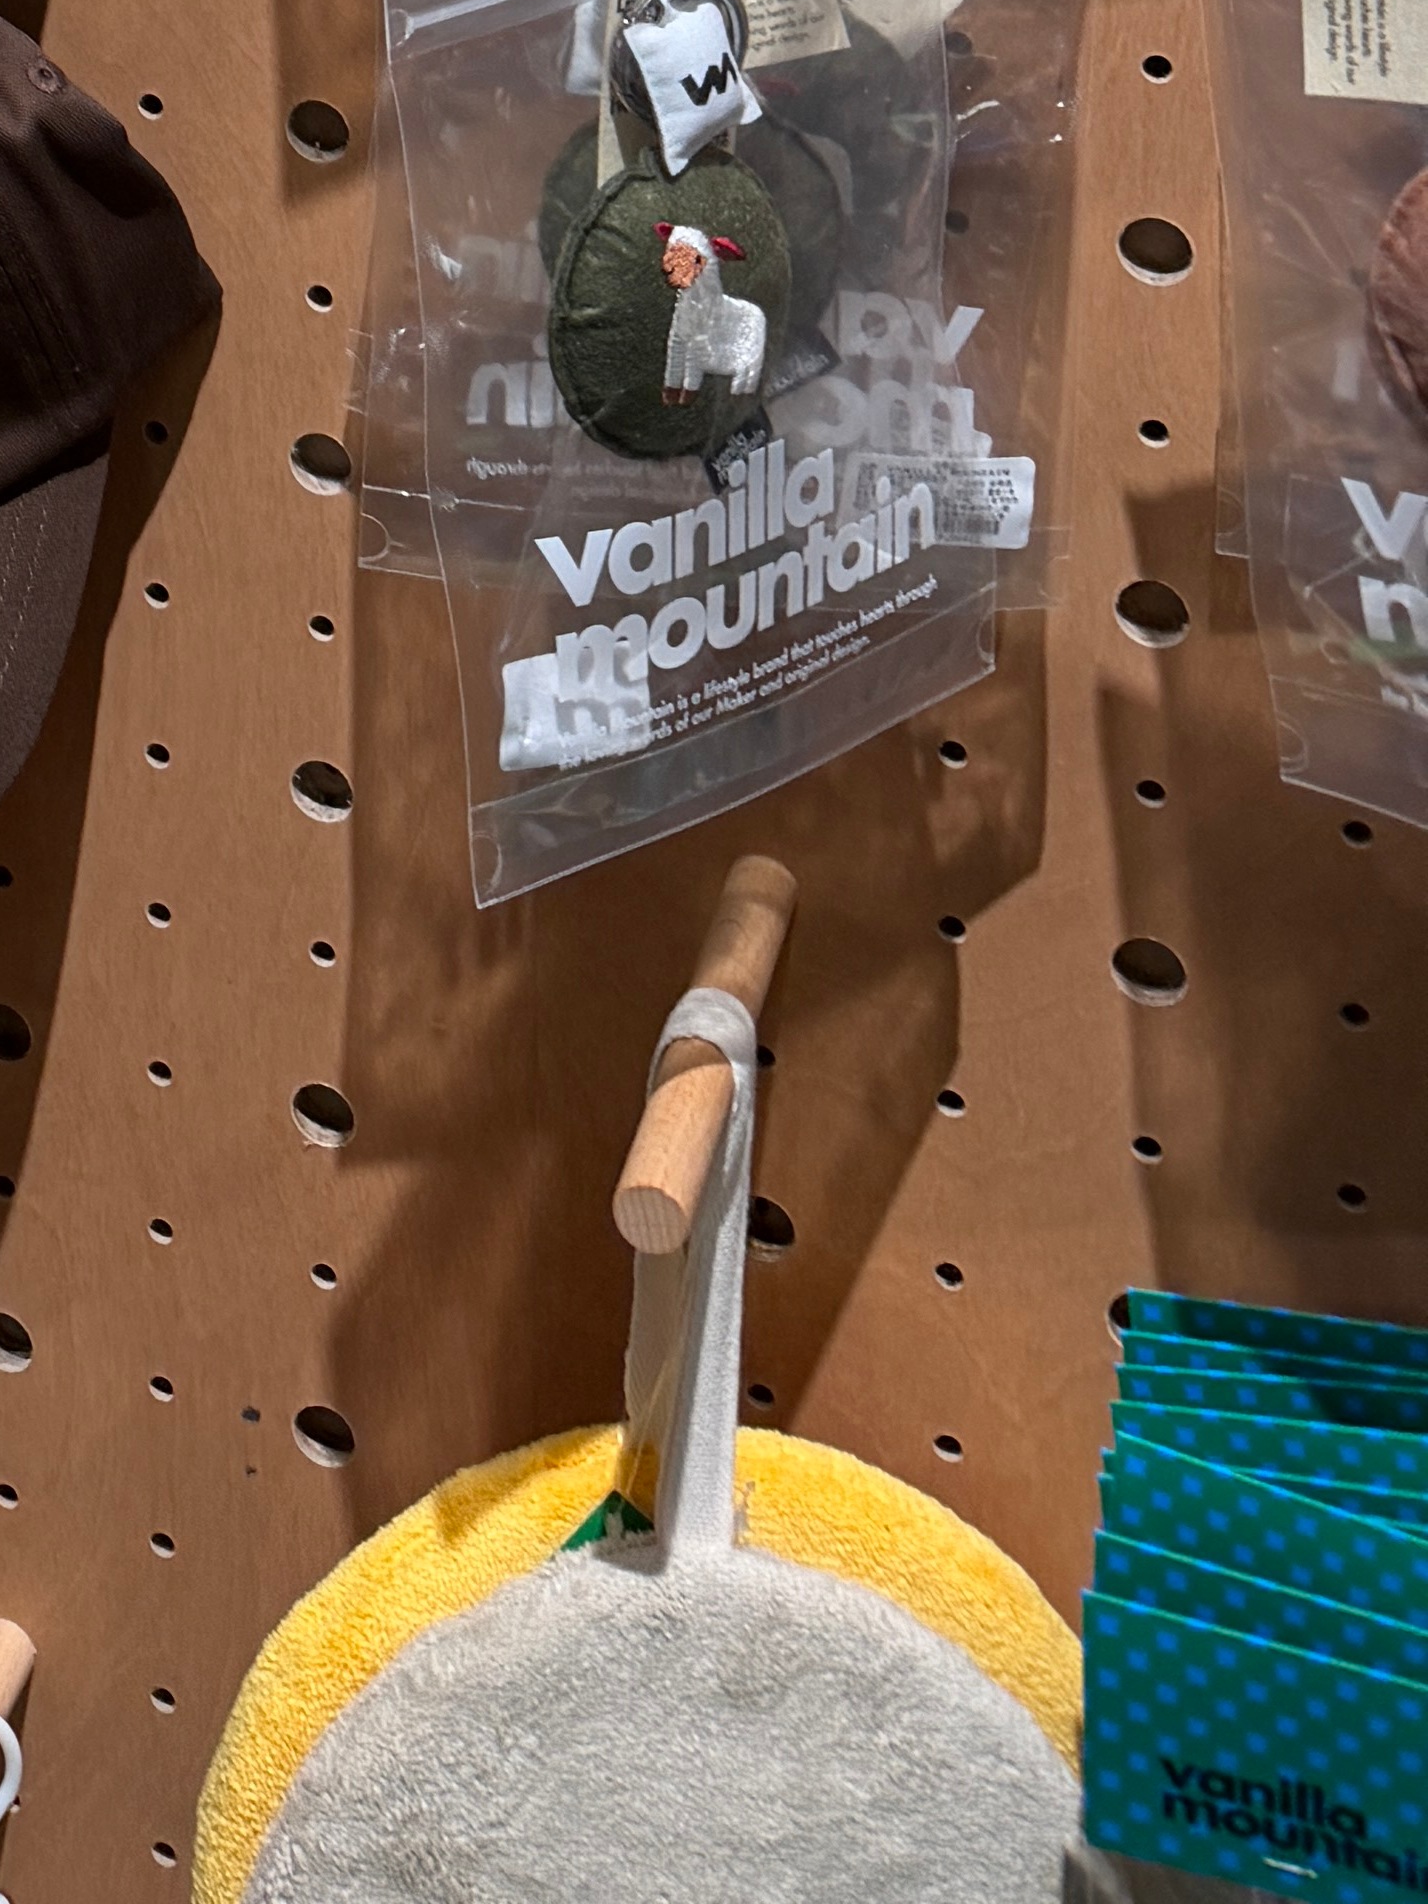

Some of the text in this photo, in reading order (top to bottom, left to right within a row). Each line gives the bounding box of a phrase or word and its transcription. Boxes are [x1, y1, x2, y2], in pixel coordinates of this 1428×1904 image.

[534, 438, 838, 608] vanilla
[555, 475, 937, 689] mountain
[753, 648, 789, 679] brand
[790, 639, 814, 661] that
[815, 619, 858, 650] touches
[896, 573, 938, 609] through
[759, 672, 783, 697] and
[1158, 1755, 1367, 1840] vanilla
